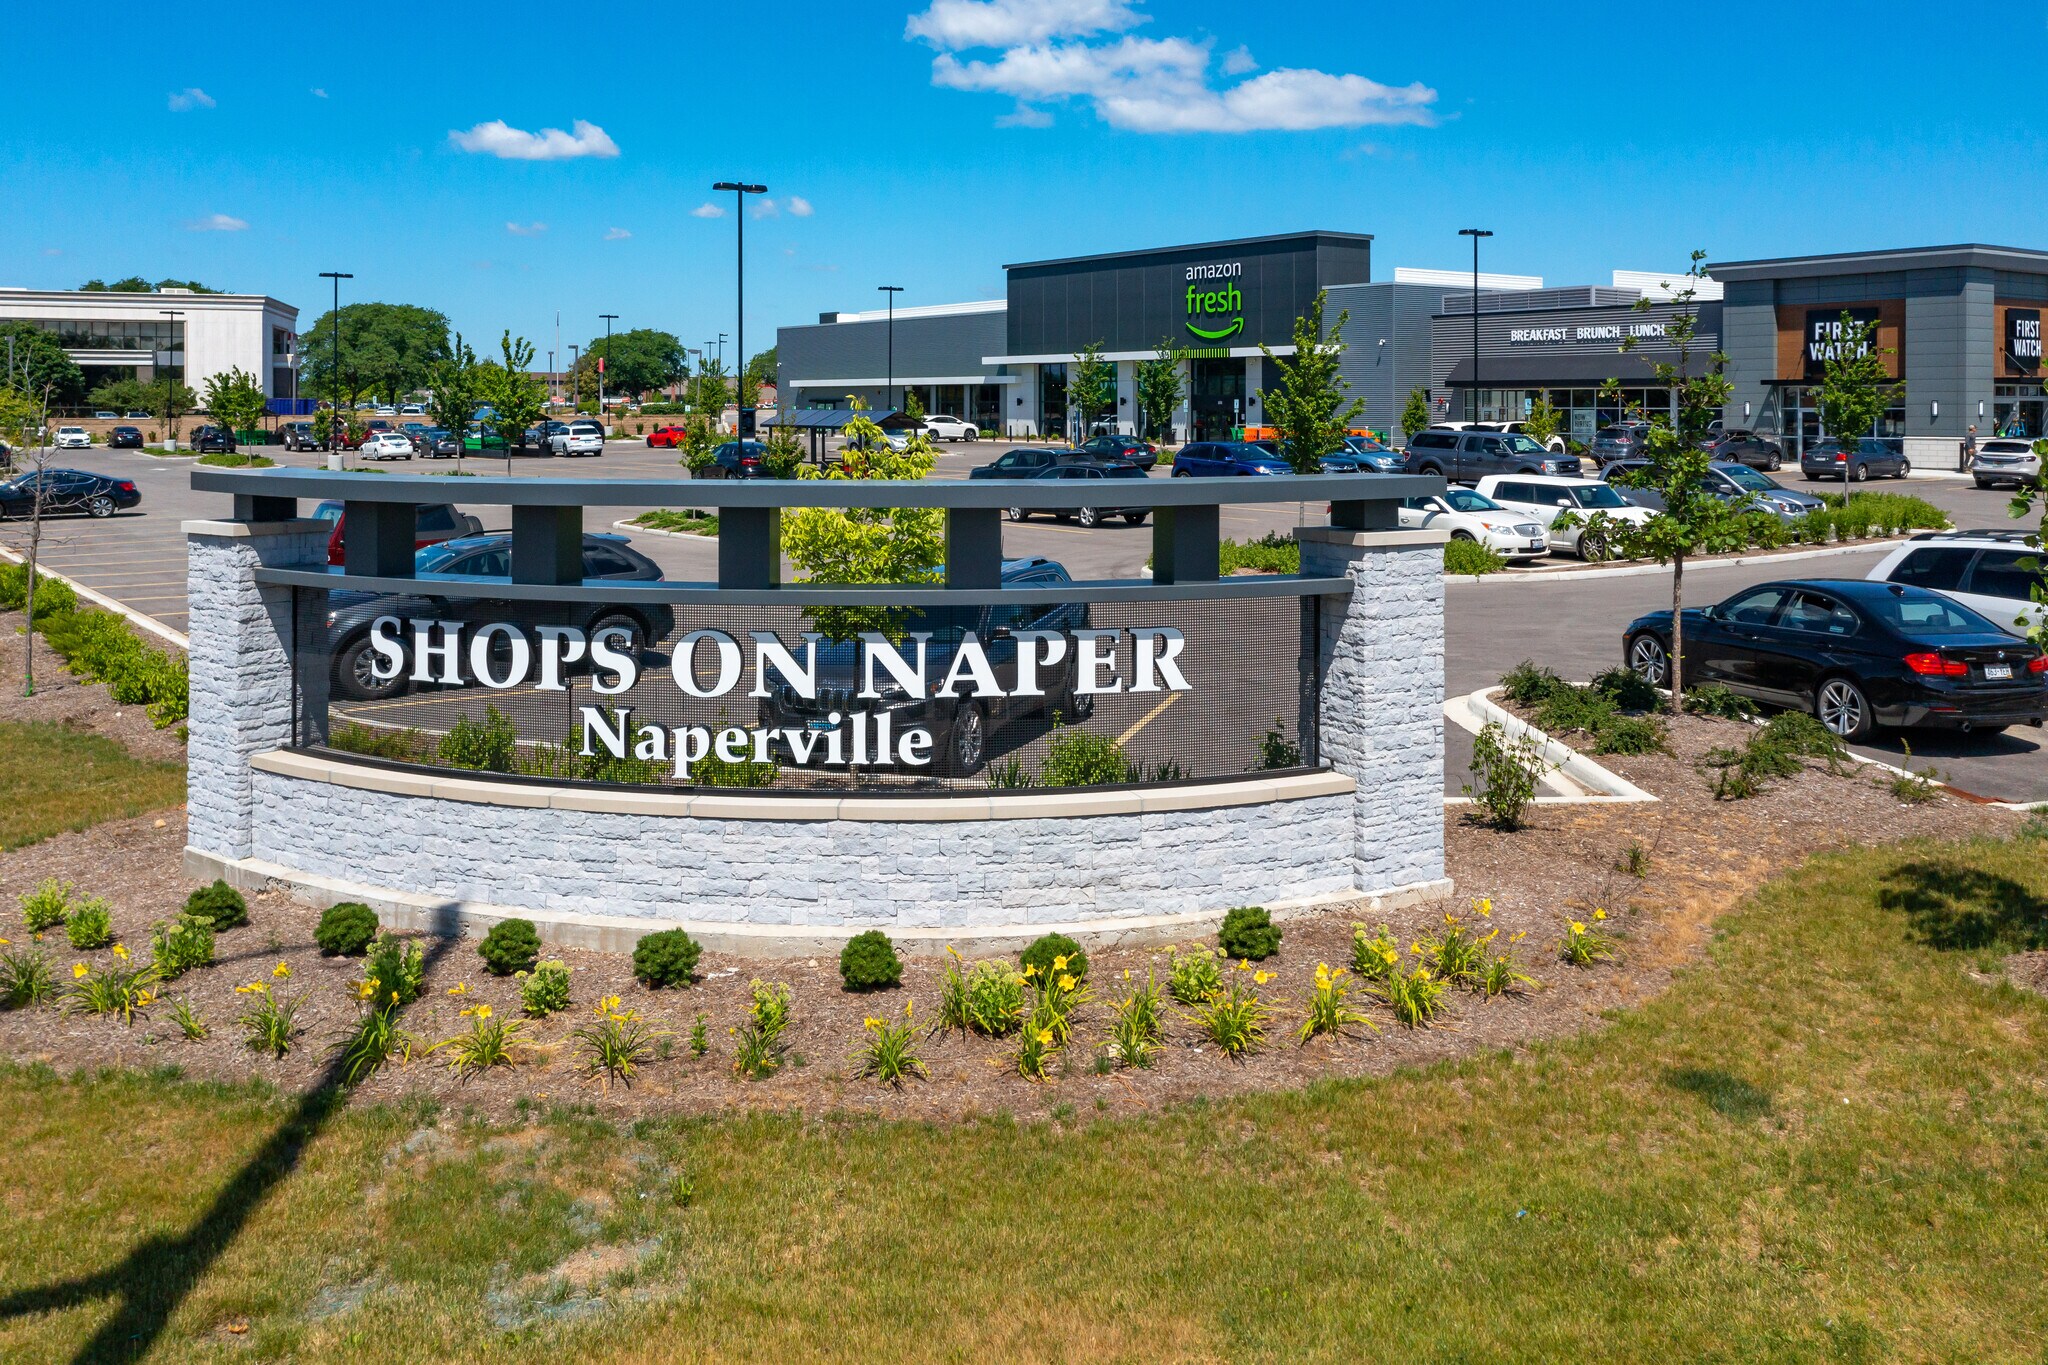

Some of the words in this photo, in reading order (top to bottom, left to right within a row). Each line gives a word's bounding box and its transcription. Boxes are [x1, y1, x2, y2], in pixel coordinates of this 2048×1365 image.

[1186, 262, 1241, 280] amazon
[1186, 282, 1241, 314] fresh
[1510, 328, 1567, 342] BREAKFAST
[1576, 326, 1620, 339] BRUNCH
[1629, 324, 1665, 337] LUNCH
[2016, 320, 2040, 338] FIRST
[2013, 339, 2042, 357] WATCH
[370, 615, 637, 694] SHOPS
[671, 629, 824, 699] ON
[857, 627, 1193, 699] NAPER
[578, 706, 934, 779] Naperville
